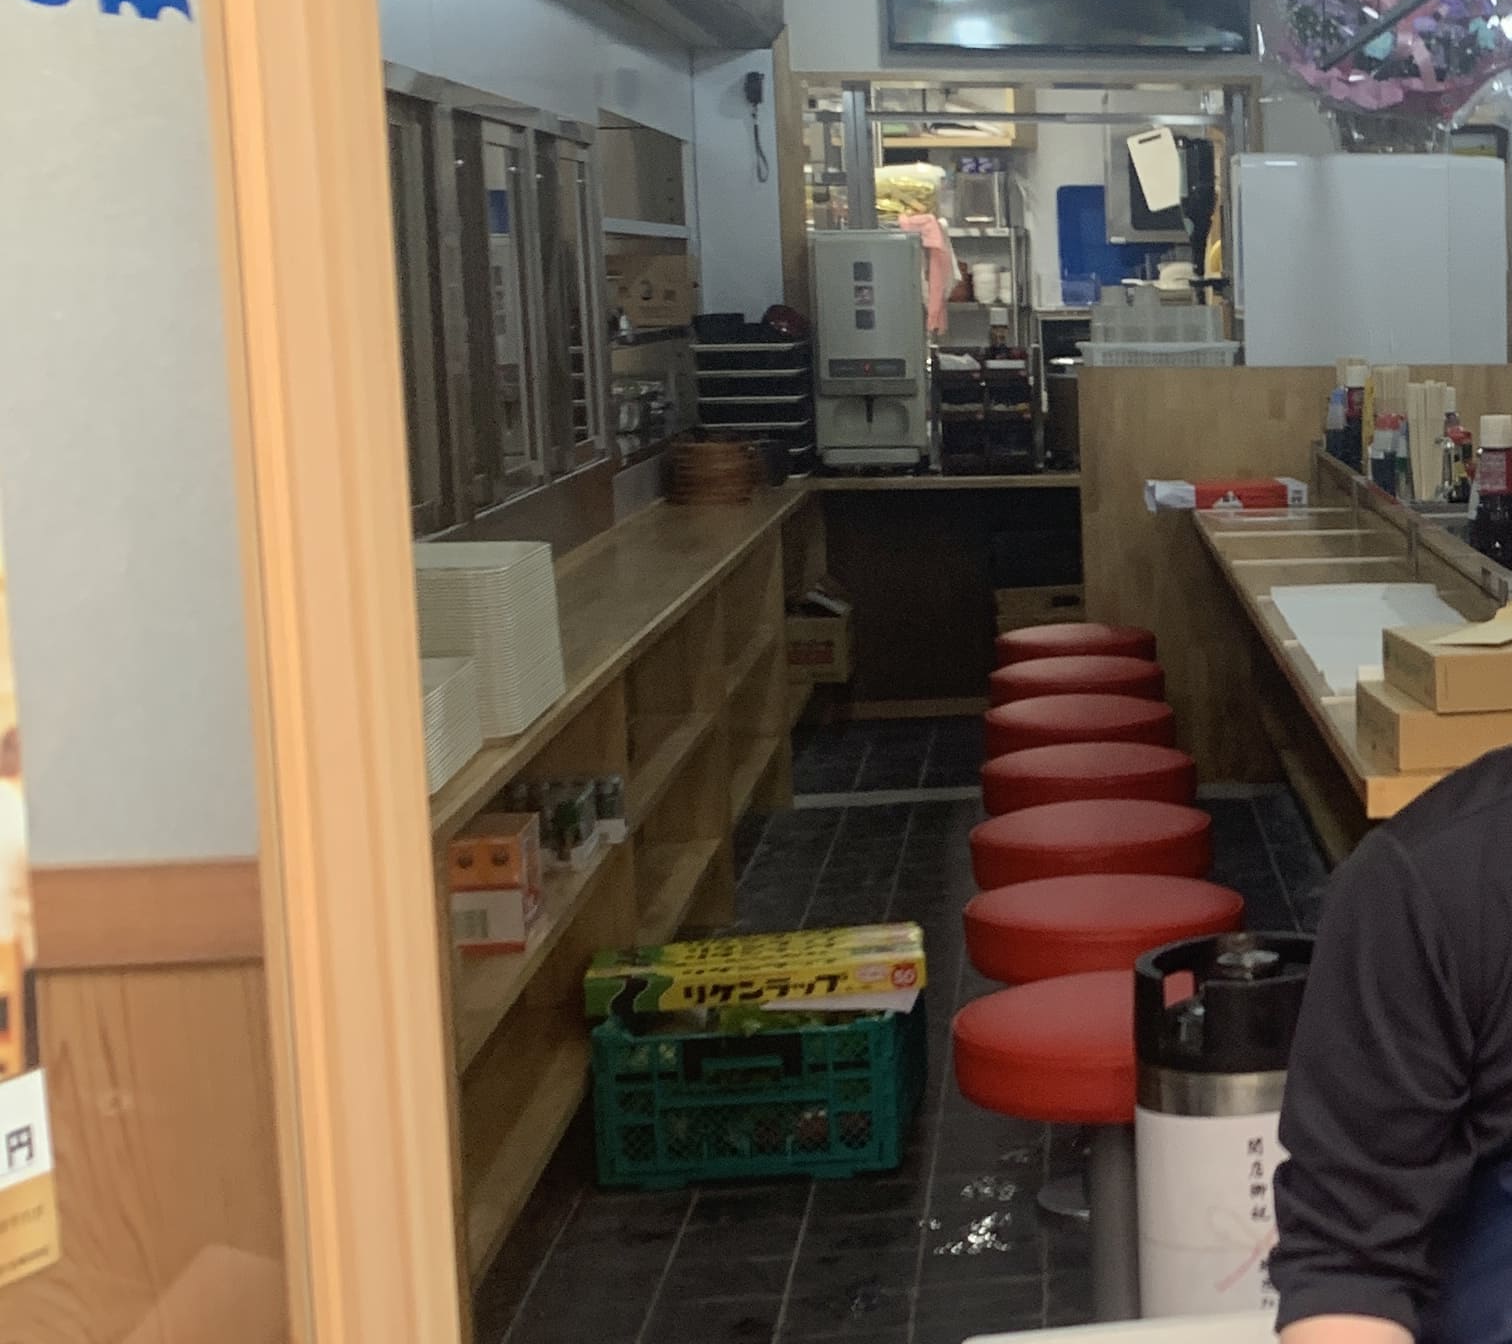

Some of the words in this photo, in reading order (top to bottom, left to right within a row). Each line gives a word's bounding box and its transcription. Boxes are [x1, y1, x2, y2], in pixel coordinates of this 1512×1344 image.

[682, 972, 848, 1005] リケンラップ
[4, 1123, 34, 1170] 円
